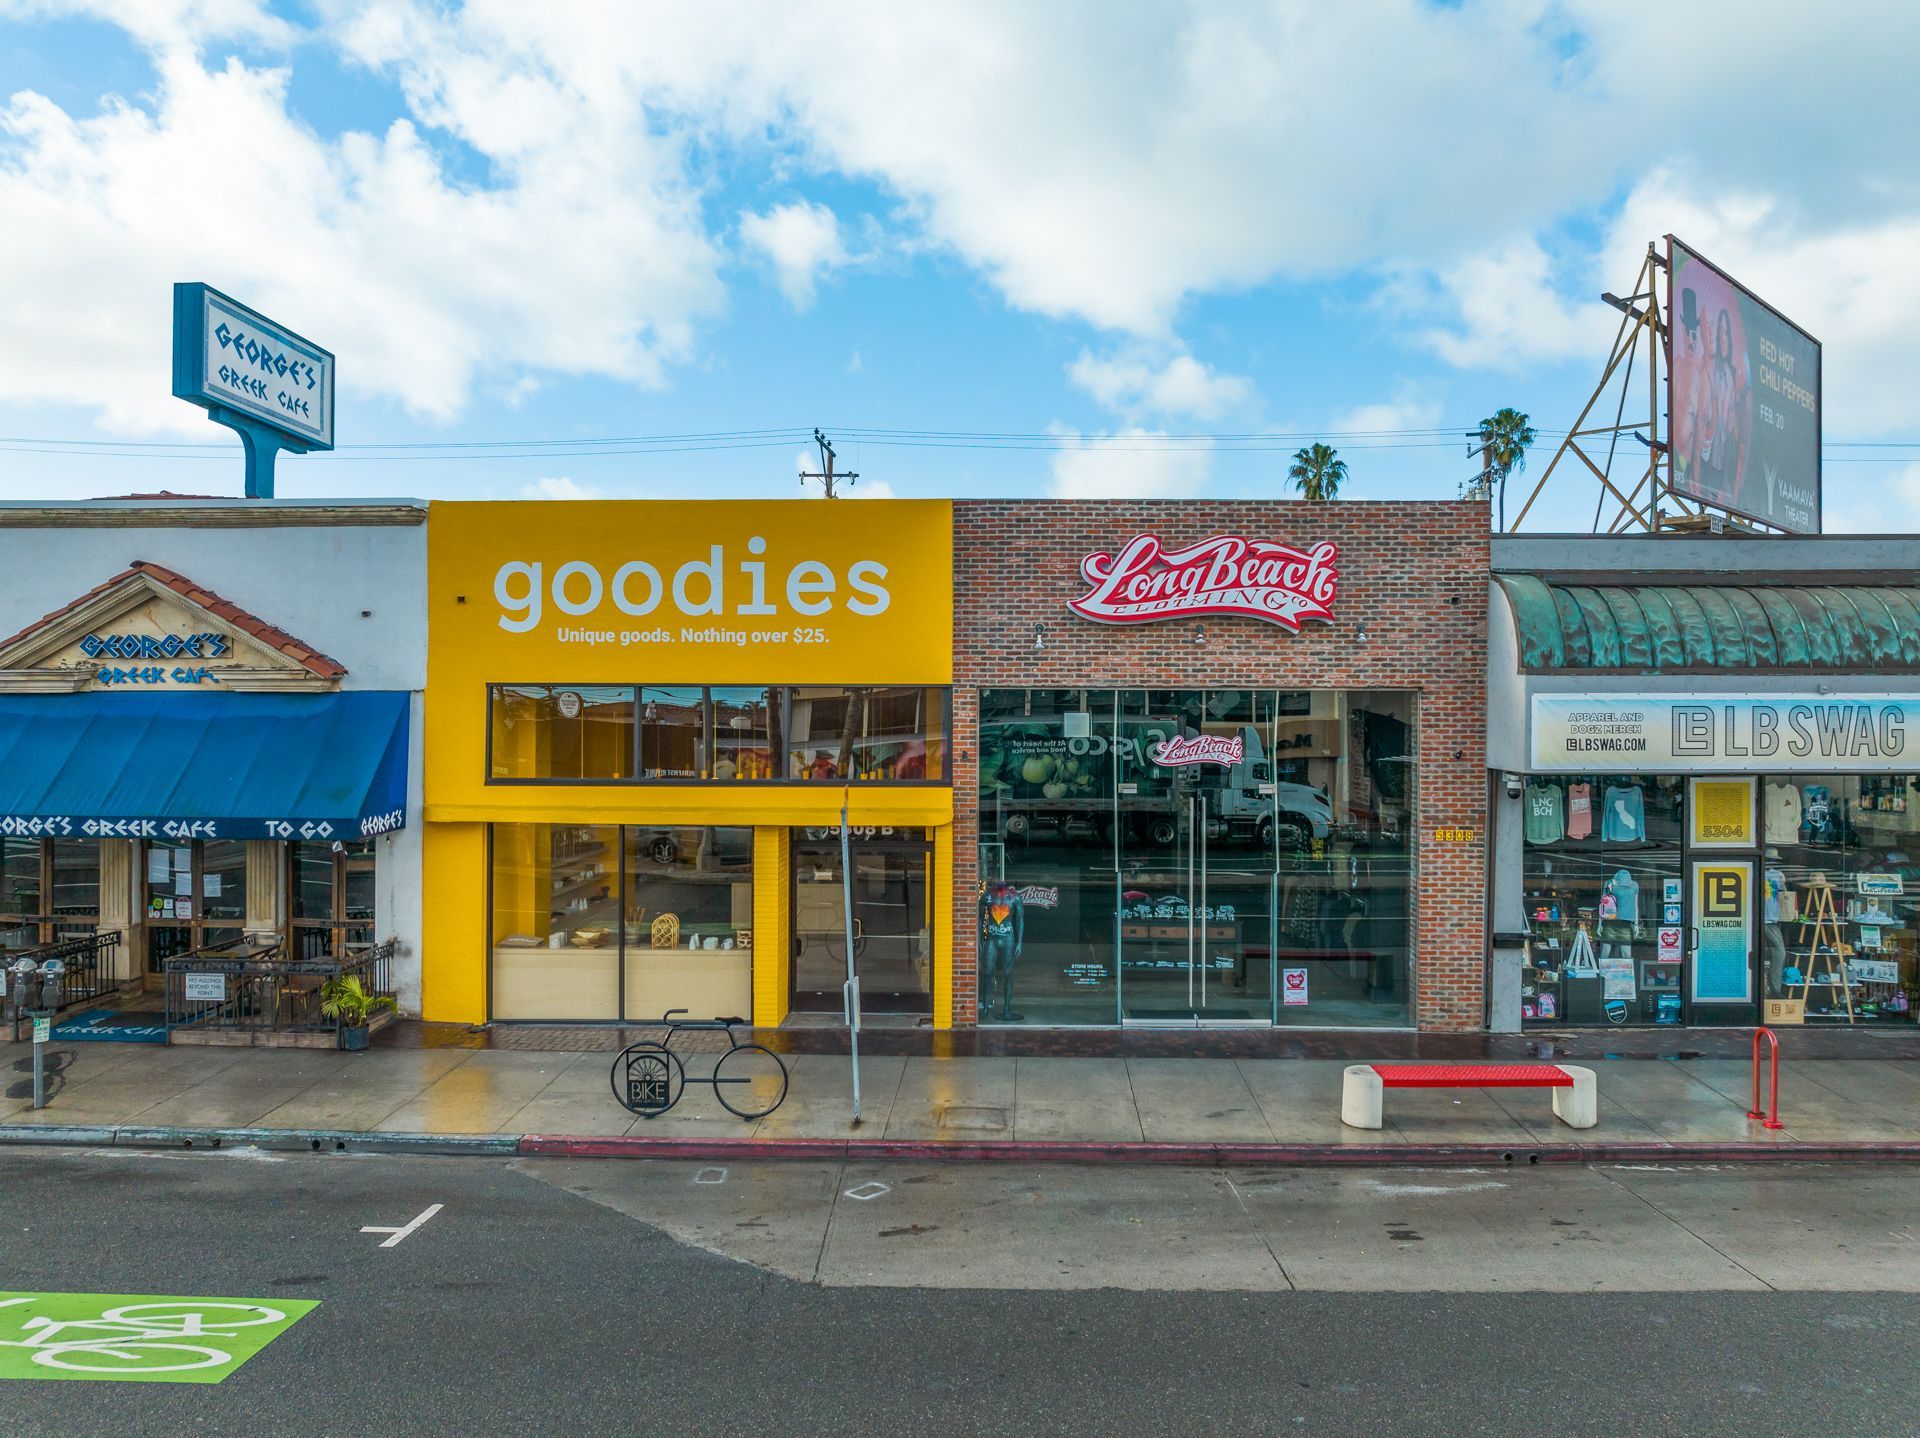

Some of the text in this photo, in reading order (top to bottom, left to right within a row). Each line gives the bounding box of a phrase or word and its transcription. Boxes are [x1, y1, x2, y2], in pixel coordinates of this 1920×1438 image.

[215, 322, 316, 391] GEORGE'S
[1760, 336, 1795, 375] RED HOT
[219, 364, 309, 419] GREEK CAFE
[1760, 364, 1815, 412] CHILI PEPPERS
[1776, 413, 1784, 430] 20
[1082, 535, 1337, 610] Long Beach
[494, 536, 890, 633] goodies
[80, 633, 227, 659] GEORGE'S
[557, 626, 830, 646] Unique goods. Nothing over $25.
[1568, 712, 1644, 722] APPAREL AND
[1571, 725, 1642, 735] DOGZ MERCH
[1724, 705, 1780, 757] LB
[1787, 704, 1905, 758] SWAG
[1196, 736, 1242, 758] Beach
[1578, 738, 1646, 751] LBSWAG.COM
[81, 819, 157, 837] GREEK
[162, 820, 217, 838] CAFE
[265, 820, 294, 838] TO
[299, 820, 335, 841] GO
[361, 809, 403, 836] GEORGE'S
[1703, 824, 1744, 838] 5304
[1436, 830, 1473, 841] 5308
[631, 1081, 665, 1100] BIKE
